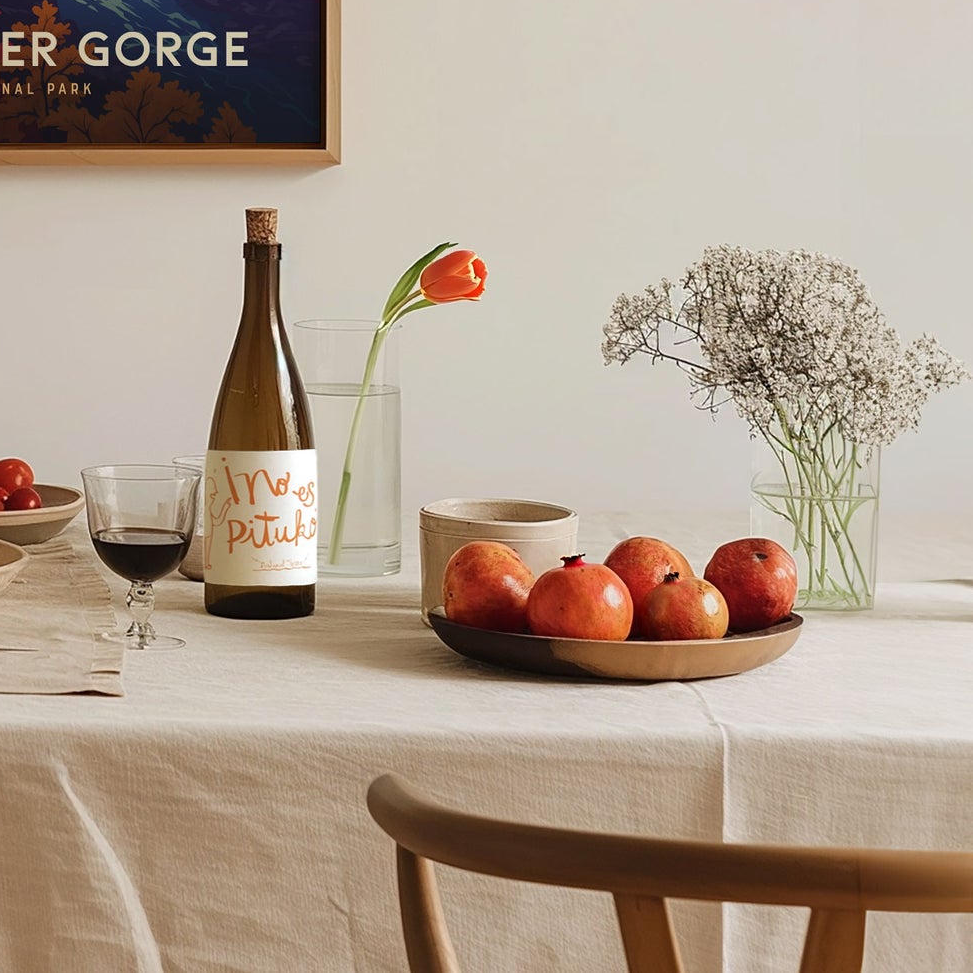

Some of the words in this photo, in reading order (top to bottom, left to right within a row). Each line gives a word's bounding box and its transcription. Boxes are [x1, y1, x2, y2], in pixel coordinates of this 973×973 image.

[78, 31, 249, 67] GORGE
[47, 82, 92, 95] PARK
[292, 481, 315, 508] es
